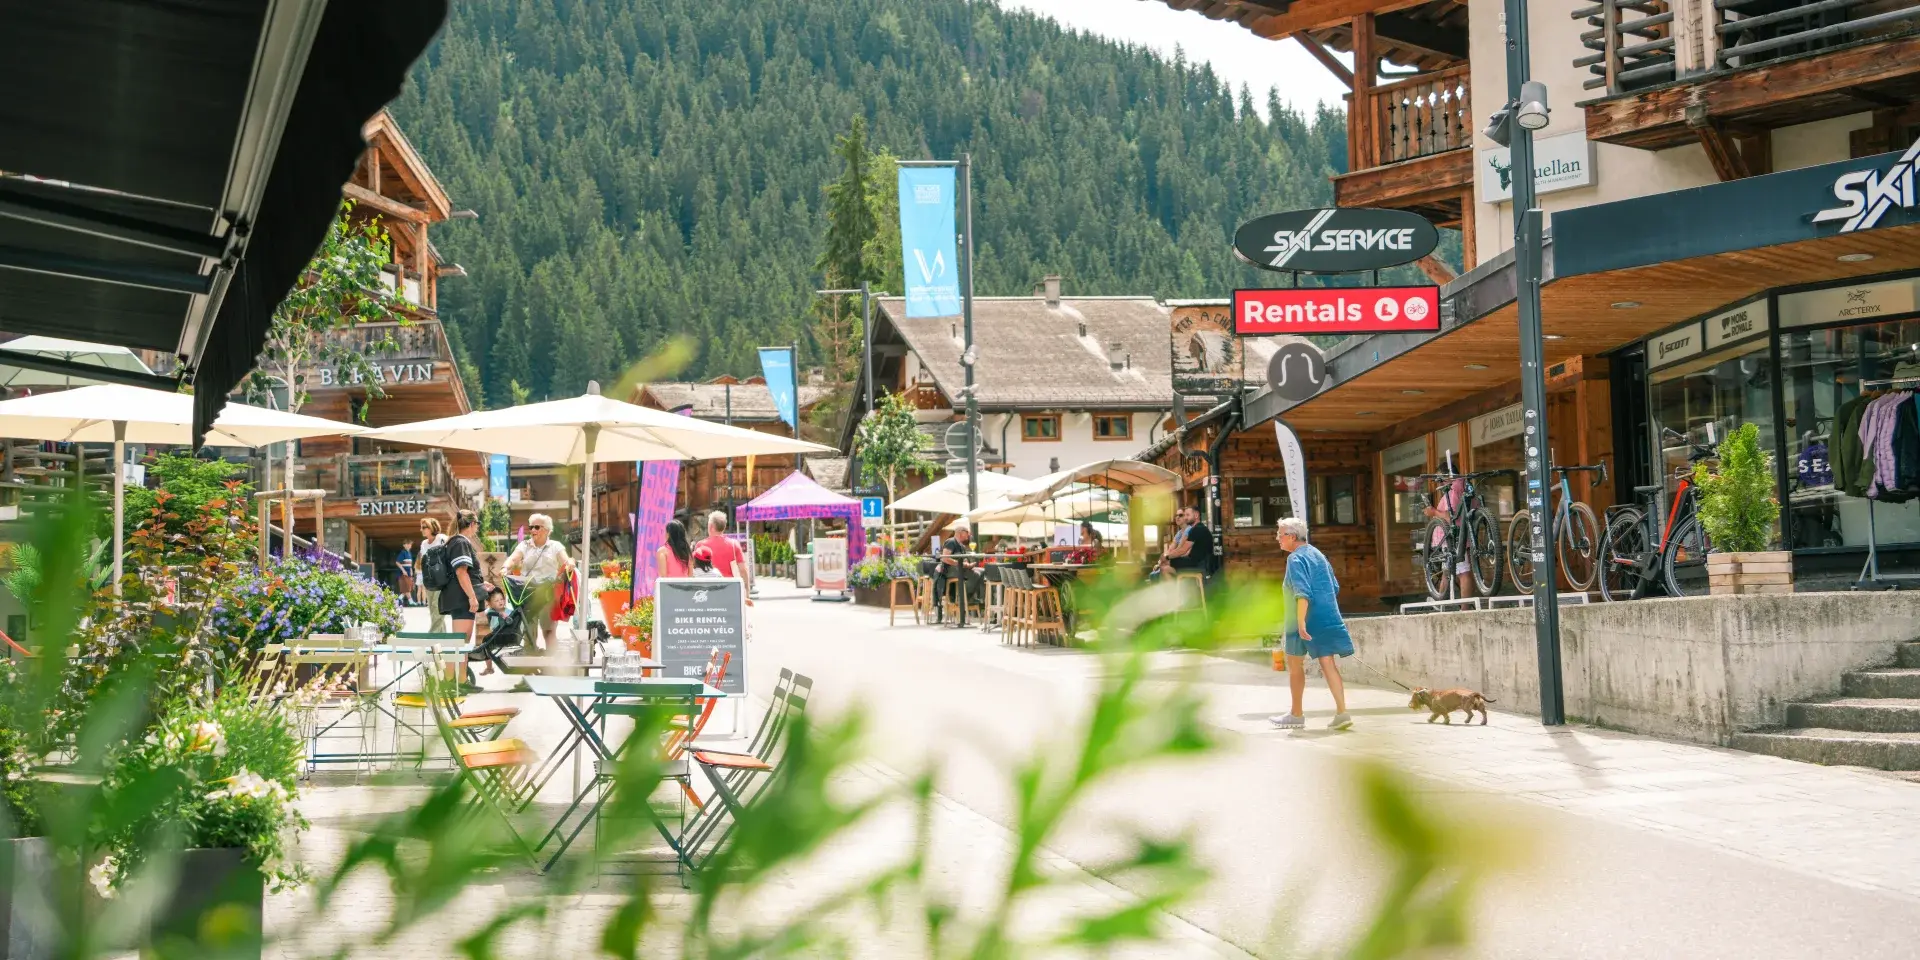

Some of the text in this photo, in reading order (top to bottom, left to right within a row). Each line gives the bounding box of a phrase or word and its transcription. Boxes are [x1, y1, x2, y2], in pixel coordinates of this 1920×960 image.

[1533, 159, 1582, 179] uellan
[1263, 210, 1416, 267] SKI SERVICE
[1243, 298, 1362, 324] Rentals
[1731, 311, 1748, 324] MONS
[1731, 321, 1753, 337] ROYALE
[1664, 336, 1691, 353] SCOTT
[320, 366, 365, 386] BR
[389, 363, 433, 382] VIN
[1489, 413, 1506, 431] JOHN
[1506, 407, 1524, 428] TAYLO
[360, 496, 426, 515] ENTRÉE
[675, 616, 727, 624] BIKE RENTAL
[667, 625, 735, 635] LOCATION VÉLO
[683, 665, 702, 676] BIKE
